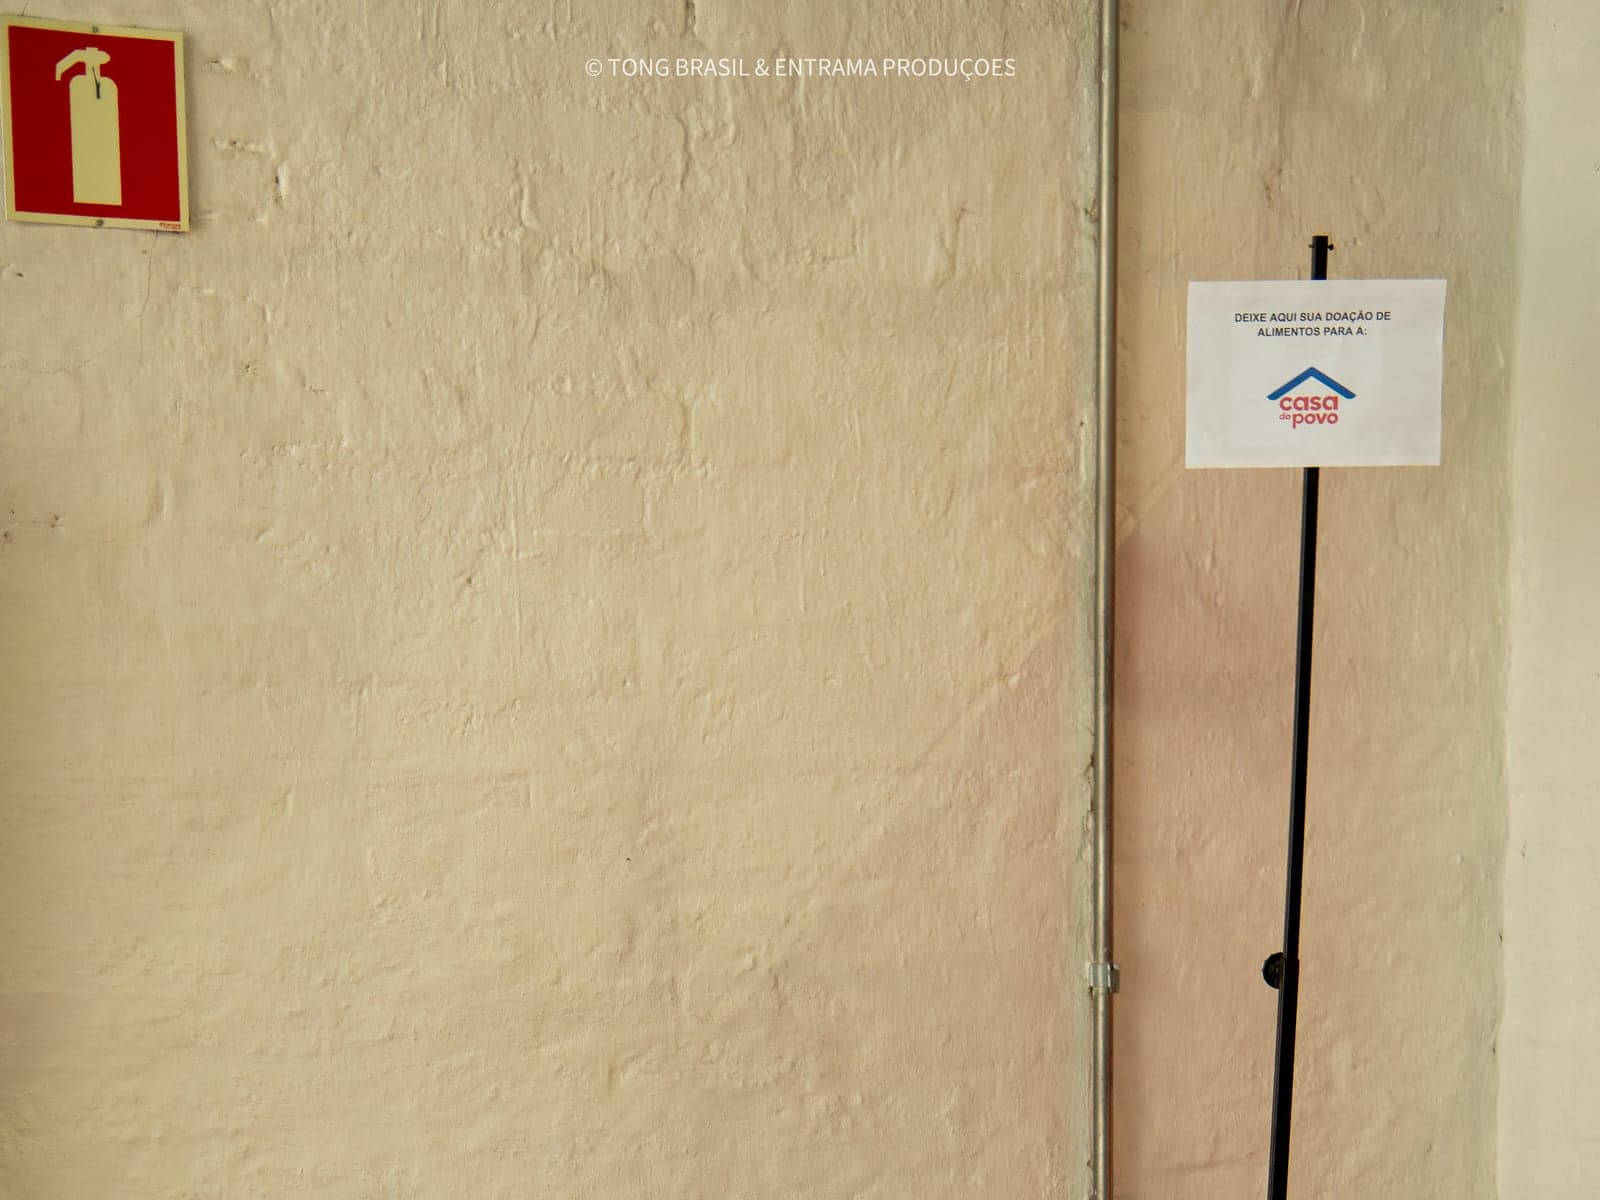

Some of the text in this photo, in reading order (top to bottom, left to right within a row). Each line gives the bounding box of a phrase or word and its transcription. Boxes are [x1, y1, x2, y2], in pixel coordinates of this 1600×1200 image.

[1234, 310, 1391, 324] DEIXE AQUI SUA DOAÇÃO DE
[1257, 327, 1367, 337] ALIMENTOS PARA A:
[1279, 395, 1339, 411] casa
[1279, 412, 1339, 429] do povo
